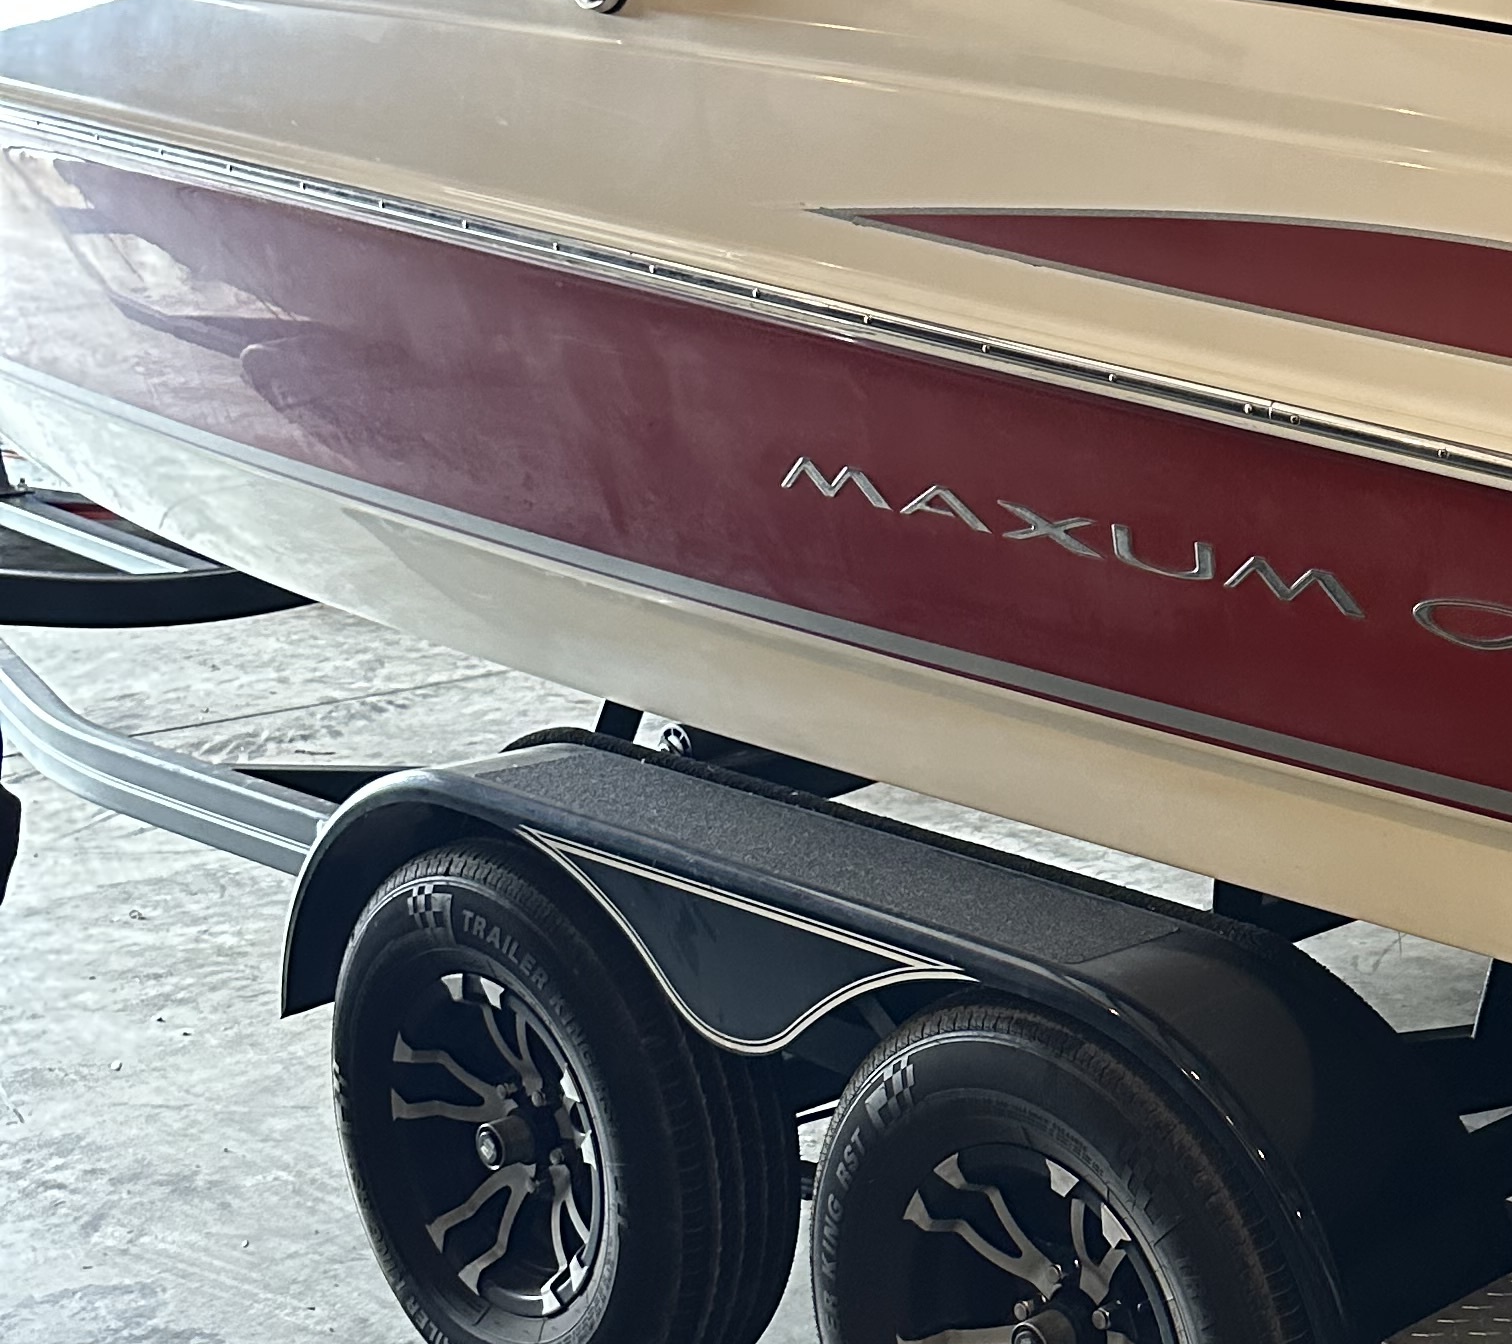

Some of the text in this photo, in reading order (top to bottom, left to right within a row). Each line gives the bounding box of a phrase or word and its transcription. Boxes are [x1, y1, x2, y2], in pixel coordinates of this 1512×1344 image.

[780, 456, 1365, 619] MAXUM
[461, 908, 549, 991] TRAILER
[820, 1126, 865, 1280] KING RST
